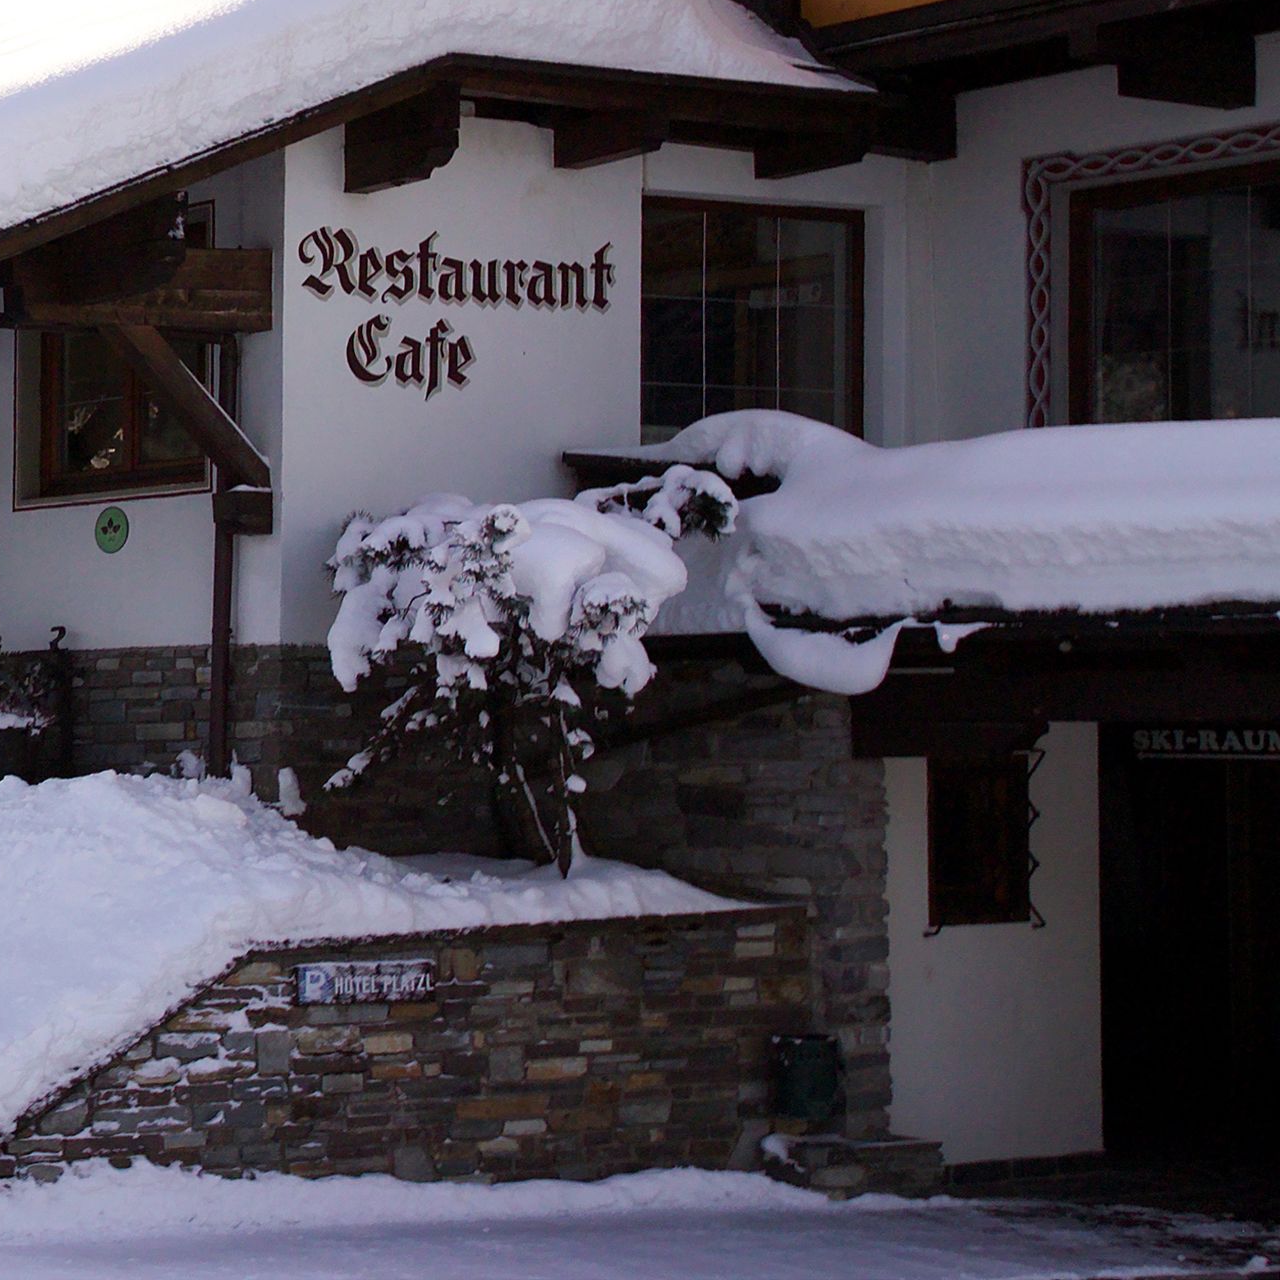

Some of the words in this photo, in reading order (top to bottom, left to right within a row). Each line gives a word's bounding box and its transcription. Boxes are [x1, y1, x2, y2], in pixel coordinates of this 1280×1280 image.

[298, 225, 617, 313] Restaurant
[345, 313, 477, 402] Cafe
[334, 975, 379, 995] HOTEL
[382, 972, 436, 993] PLATZL
